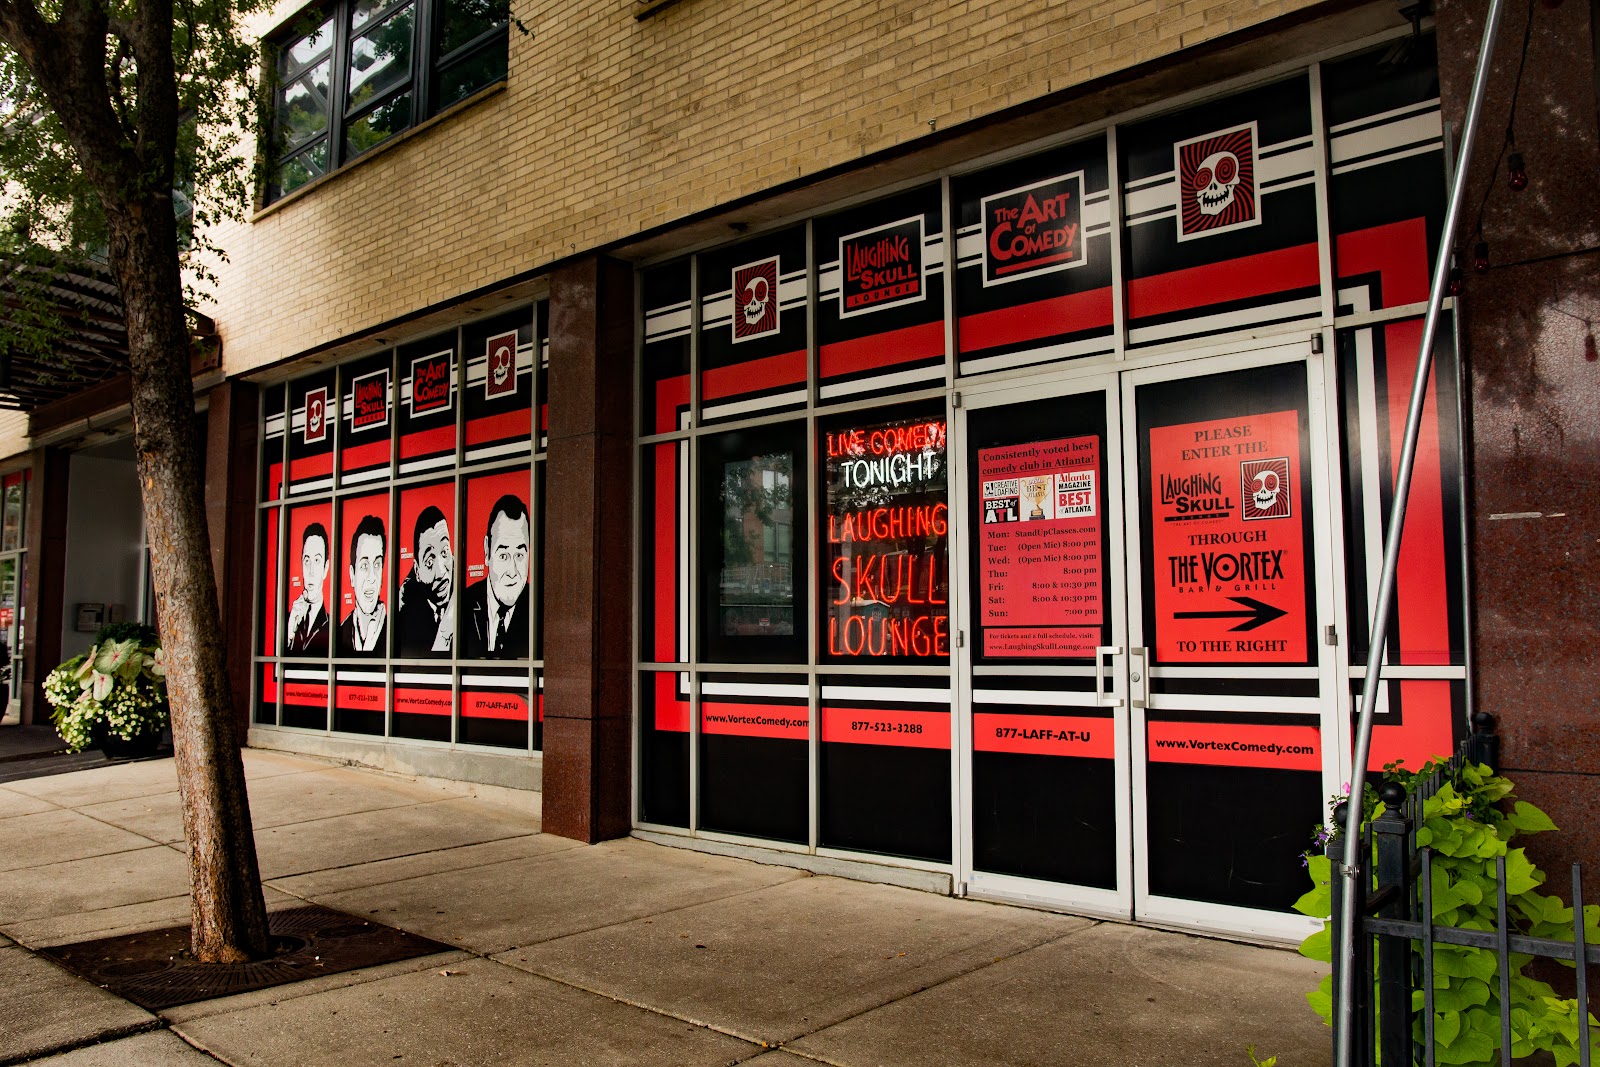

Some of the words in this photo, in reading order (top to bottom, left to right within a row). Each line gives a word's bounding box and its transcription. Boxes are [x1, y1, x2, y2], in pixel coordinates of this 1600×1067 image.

[994, 206, 1018, 223] The
[1017, 192, 1070, 229] ART
[1025, 224, 1036, 234] of
[990, 222, 1077, 261] COMEDY
[847, 237, 909, 281] LAUGHING
[860, 263, 917, 290] SKULL
[854, 284, 911, 304] LOUNGE
[417, 368, 426, 377] The
[426, 361, 446, 382] ART
[356, 381, 382, 408] LAUGHING
[414, 378, 448, 402] COMEDY
[361, 400, 384, 414] SKULL
[828, 431, 865, 456] LIVE
[871, 422, 946, 455] COMEDY
[1194, 425, 1252, 443] PLEASE
[983, 448, 1041, 462] Consistently
[1043, 444, 1069, 455] voted
[1072, 442, 1093, 452] best
[1181, 445, 1230, 461] ENTER
[1235, 441, 1268, 454] THE
[841, 452, 937, 488] TONIGHT
[982, 461, 1017, 475] comedy
[1019, 461, 1040, 470] club
[1042, 460, 1052, 468] in
[1055, 455, 1095, 467] Atlanta!
[994, 480, 1017, 488] CREATIVE
[1059, 473, 1090, 482] Atlanta
[1059, 481, 1091, 489] MAGAZINE
[994, 487, 1018, 496] LOAFING
[1161, 472, 1221, 504] LAUGHING
[986, 500, 1010, 510] BEST
[1059, 491, 1091, 506] BEST
[1176, 497, 1234, 513] SKULL
[829, 504, 947, 543] LAUGHING
[985, 508, 1017, 523] ATL
[988, 531, 1010, 539] Mon:
[1015, 525, 1096, 539] StandUpClasses.com
[1188, 530, 1267, 546] THROUGH
[988, 544, 1006, 552] Tue:
[1018, 542, 1042, 551] (Open
[1043, 541, 1061, 550] Mic)
[1063, 540, 1081, 548] 8:00
[1083, 540, 1096, 548] pm
[1018, 555, 1042, 564] (Open
[1044, 554, 1061, 563] Mic)
[1063, 553, 1082, 561] 8:00
[1084, 554, 1096, 562] pm
[988, 570, 1008, 578] Thu:
[1063, 567, 1082, 575] 8:00
[1084, 567, 1097, 575] pm
[1168, 555, 1198, 587] THE
[1201, 549, 1284, 591] VORTEX
[832, 554, 946, 605] SKULL
[988, 583, 1004, 591] Fri:
[1053, 581, 1058, 589] &
[1060, 581, 1082, 589] 10:30
[1084, 581, 1097, 589] pm
[1179, 584, 1204, 594] BAR
[1215, 584, 1222, 592] &
[1234, 583, 1276, 592] GRILL
[988, 596, 1005, 604] Sat:
[1032, 595, 1051, 603] 8:00
[1053, 594, 1059, 602] &
[1060, 594, 1082, 603] 10:30
[988, 609, 1008, 617] Sun:
[1065, 608, 1083, 616] 7:00
[1085, 608, 1098, 616] pm
[829, 615, 950, 656] LOUNGE
[989, 643, 1096, 651] www.LaughingSkullLounge.com
[1177, 640, 1196, 652] TO
[1199, 640, 1233, 652] THE
[1235, 640, 1287, 652] RIGHT
[397, 698, 452, 707] www.VortexComedy.co
[476, 701, 518, 710] 877-LAFF-AT-U
[850, 721, 923, 736] 877-523-3288
[995, 726, 1091, 744] 877-LAFF-AT-U
[1154, 737, 1314, 757] www.VortexComedy.com
